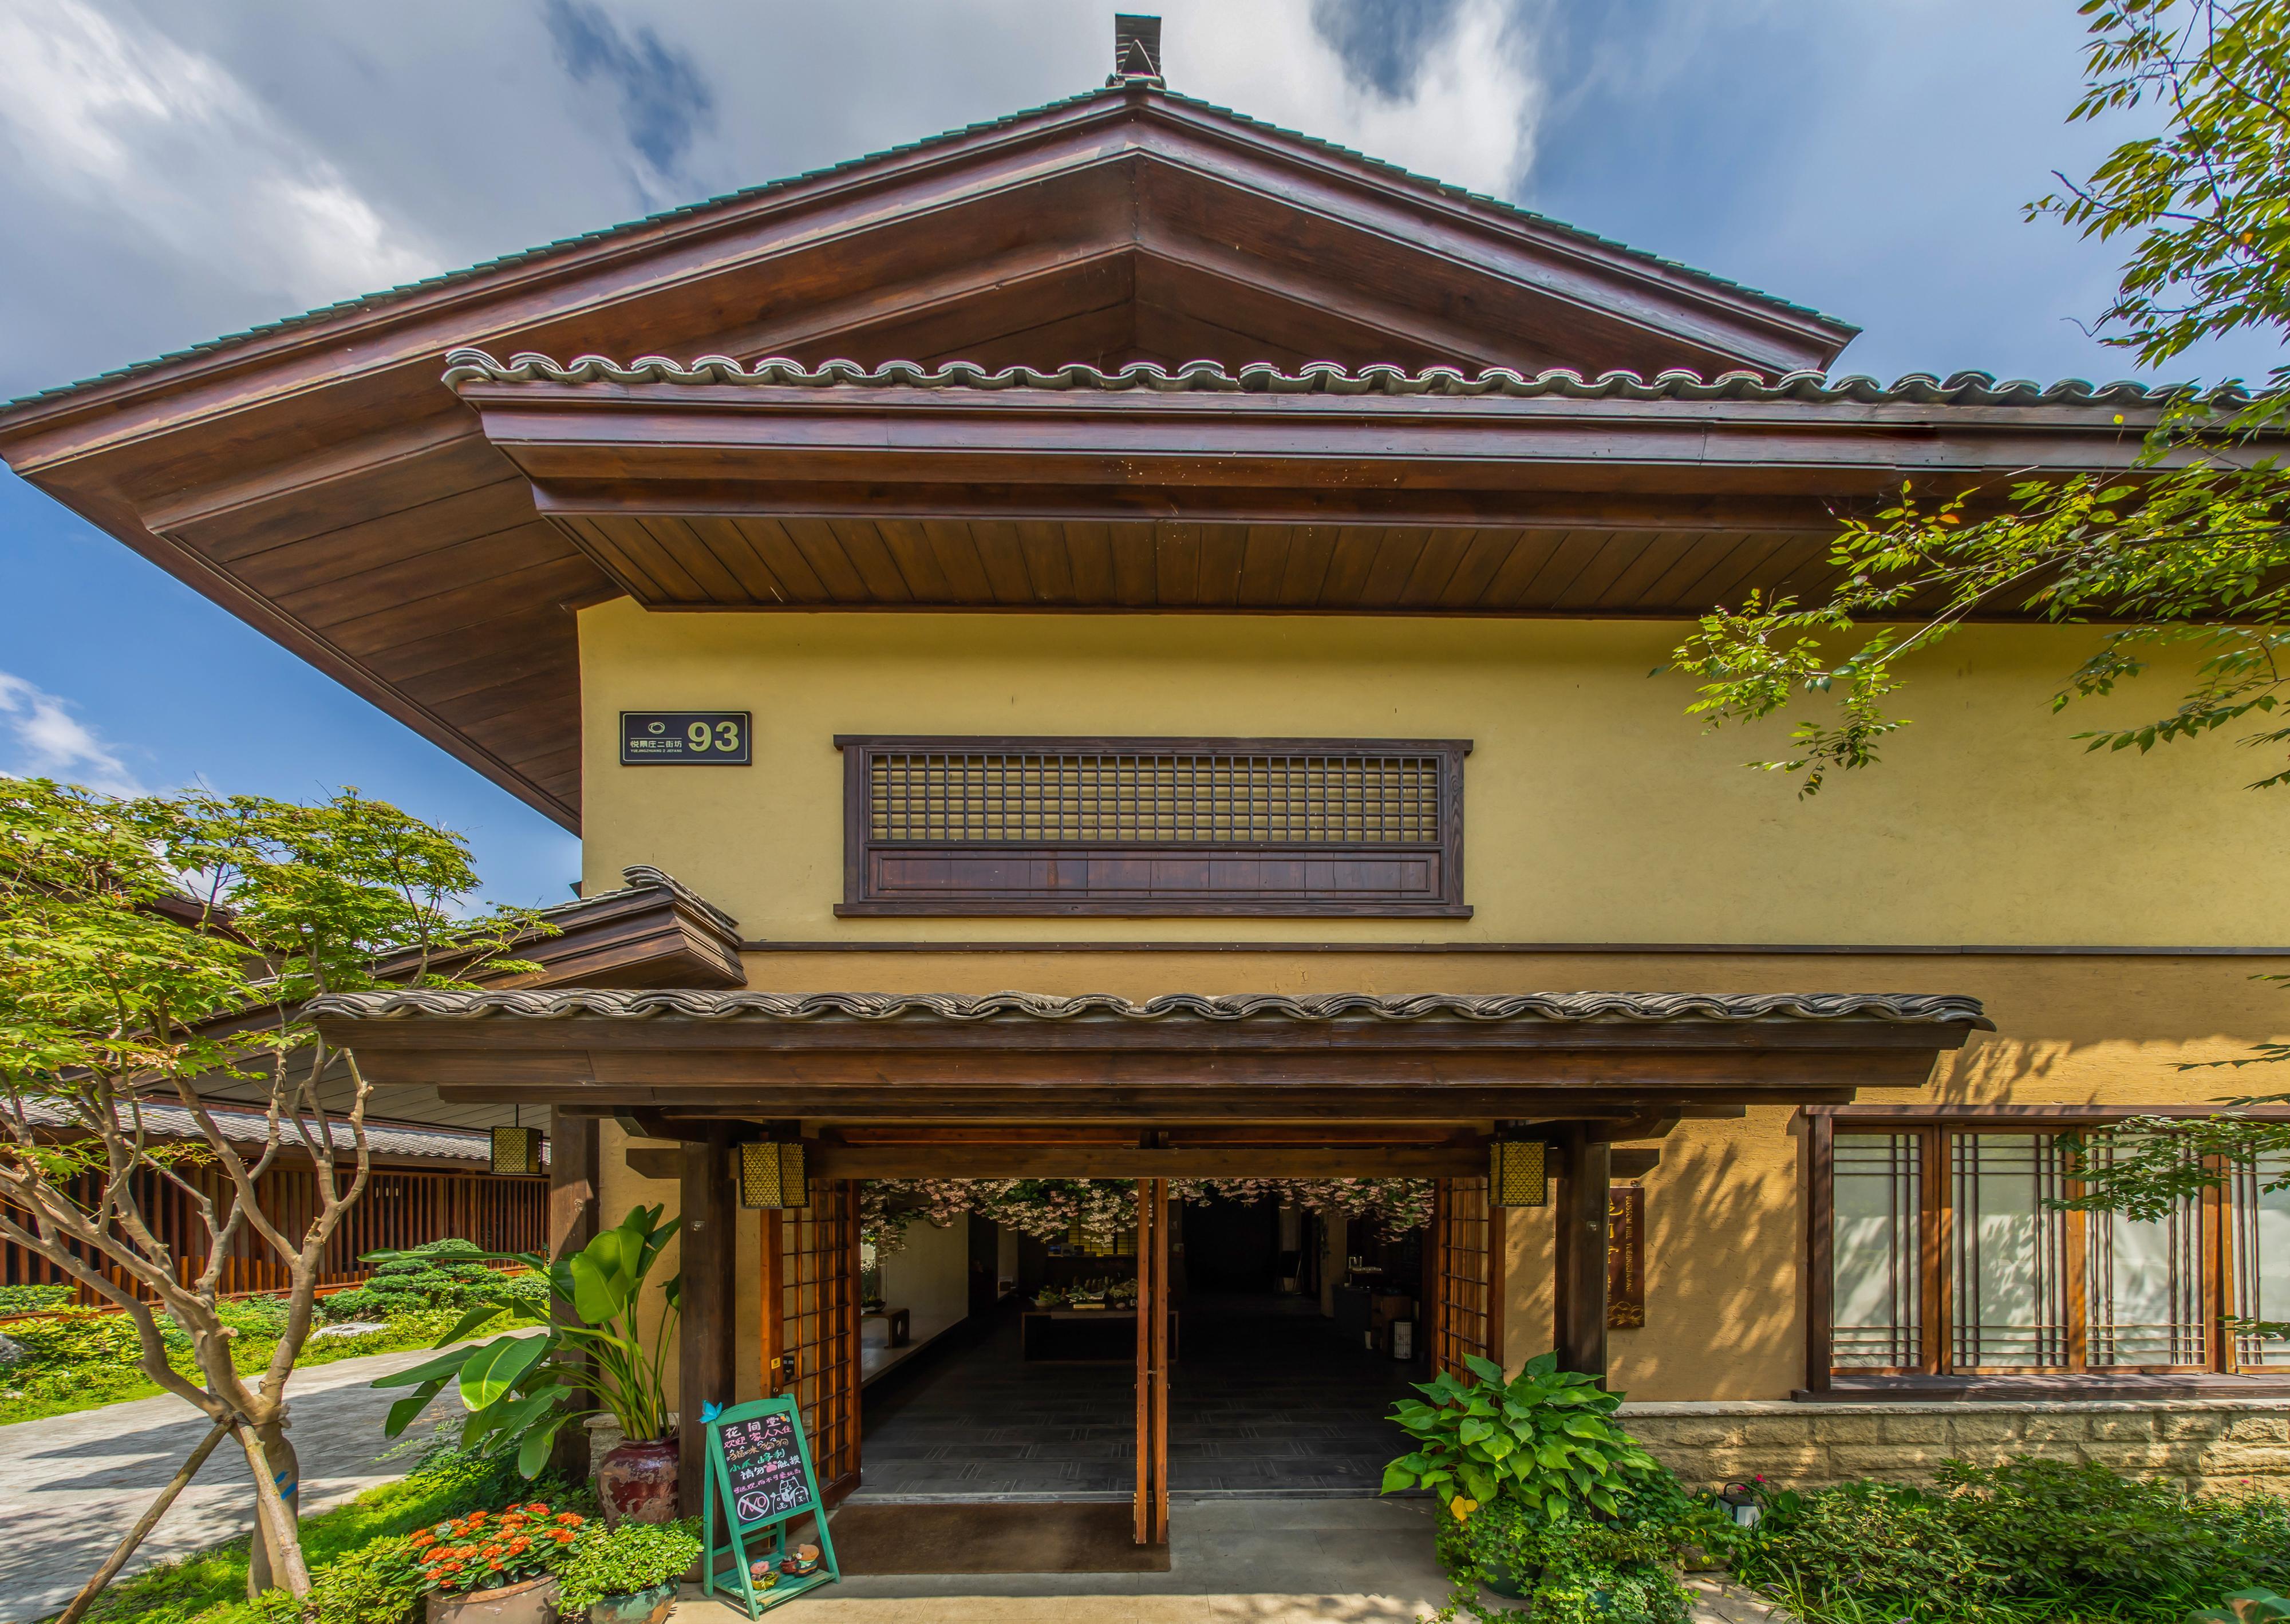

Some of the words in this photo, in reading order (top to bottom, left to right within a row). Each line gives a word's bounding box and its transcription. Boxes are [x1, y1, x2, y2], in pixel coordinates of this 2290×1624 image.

[688, 721, 739, 752] 93
[725, 1417, 781, 1439] 花间堂
[742, 1496, 767, 1516] NO
